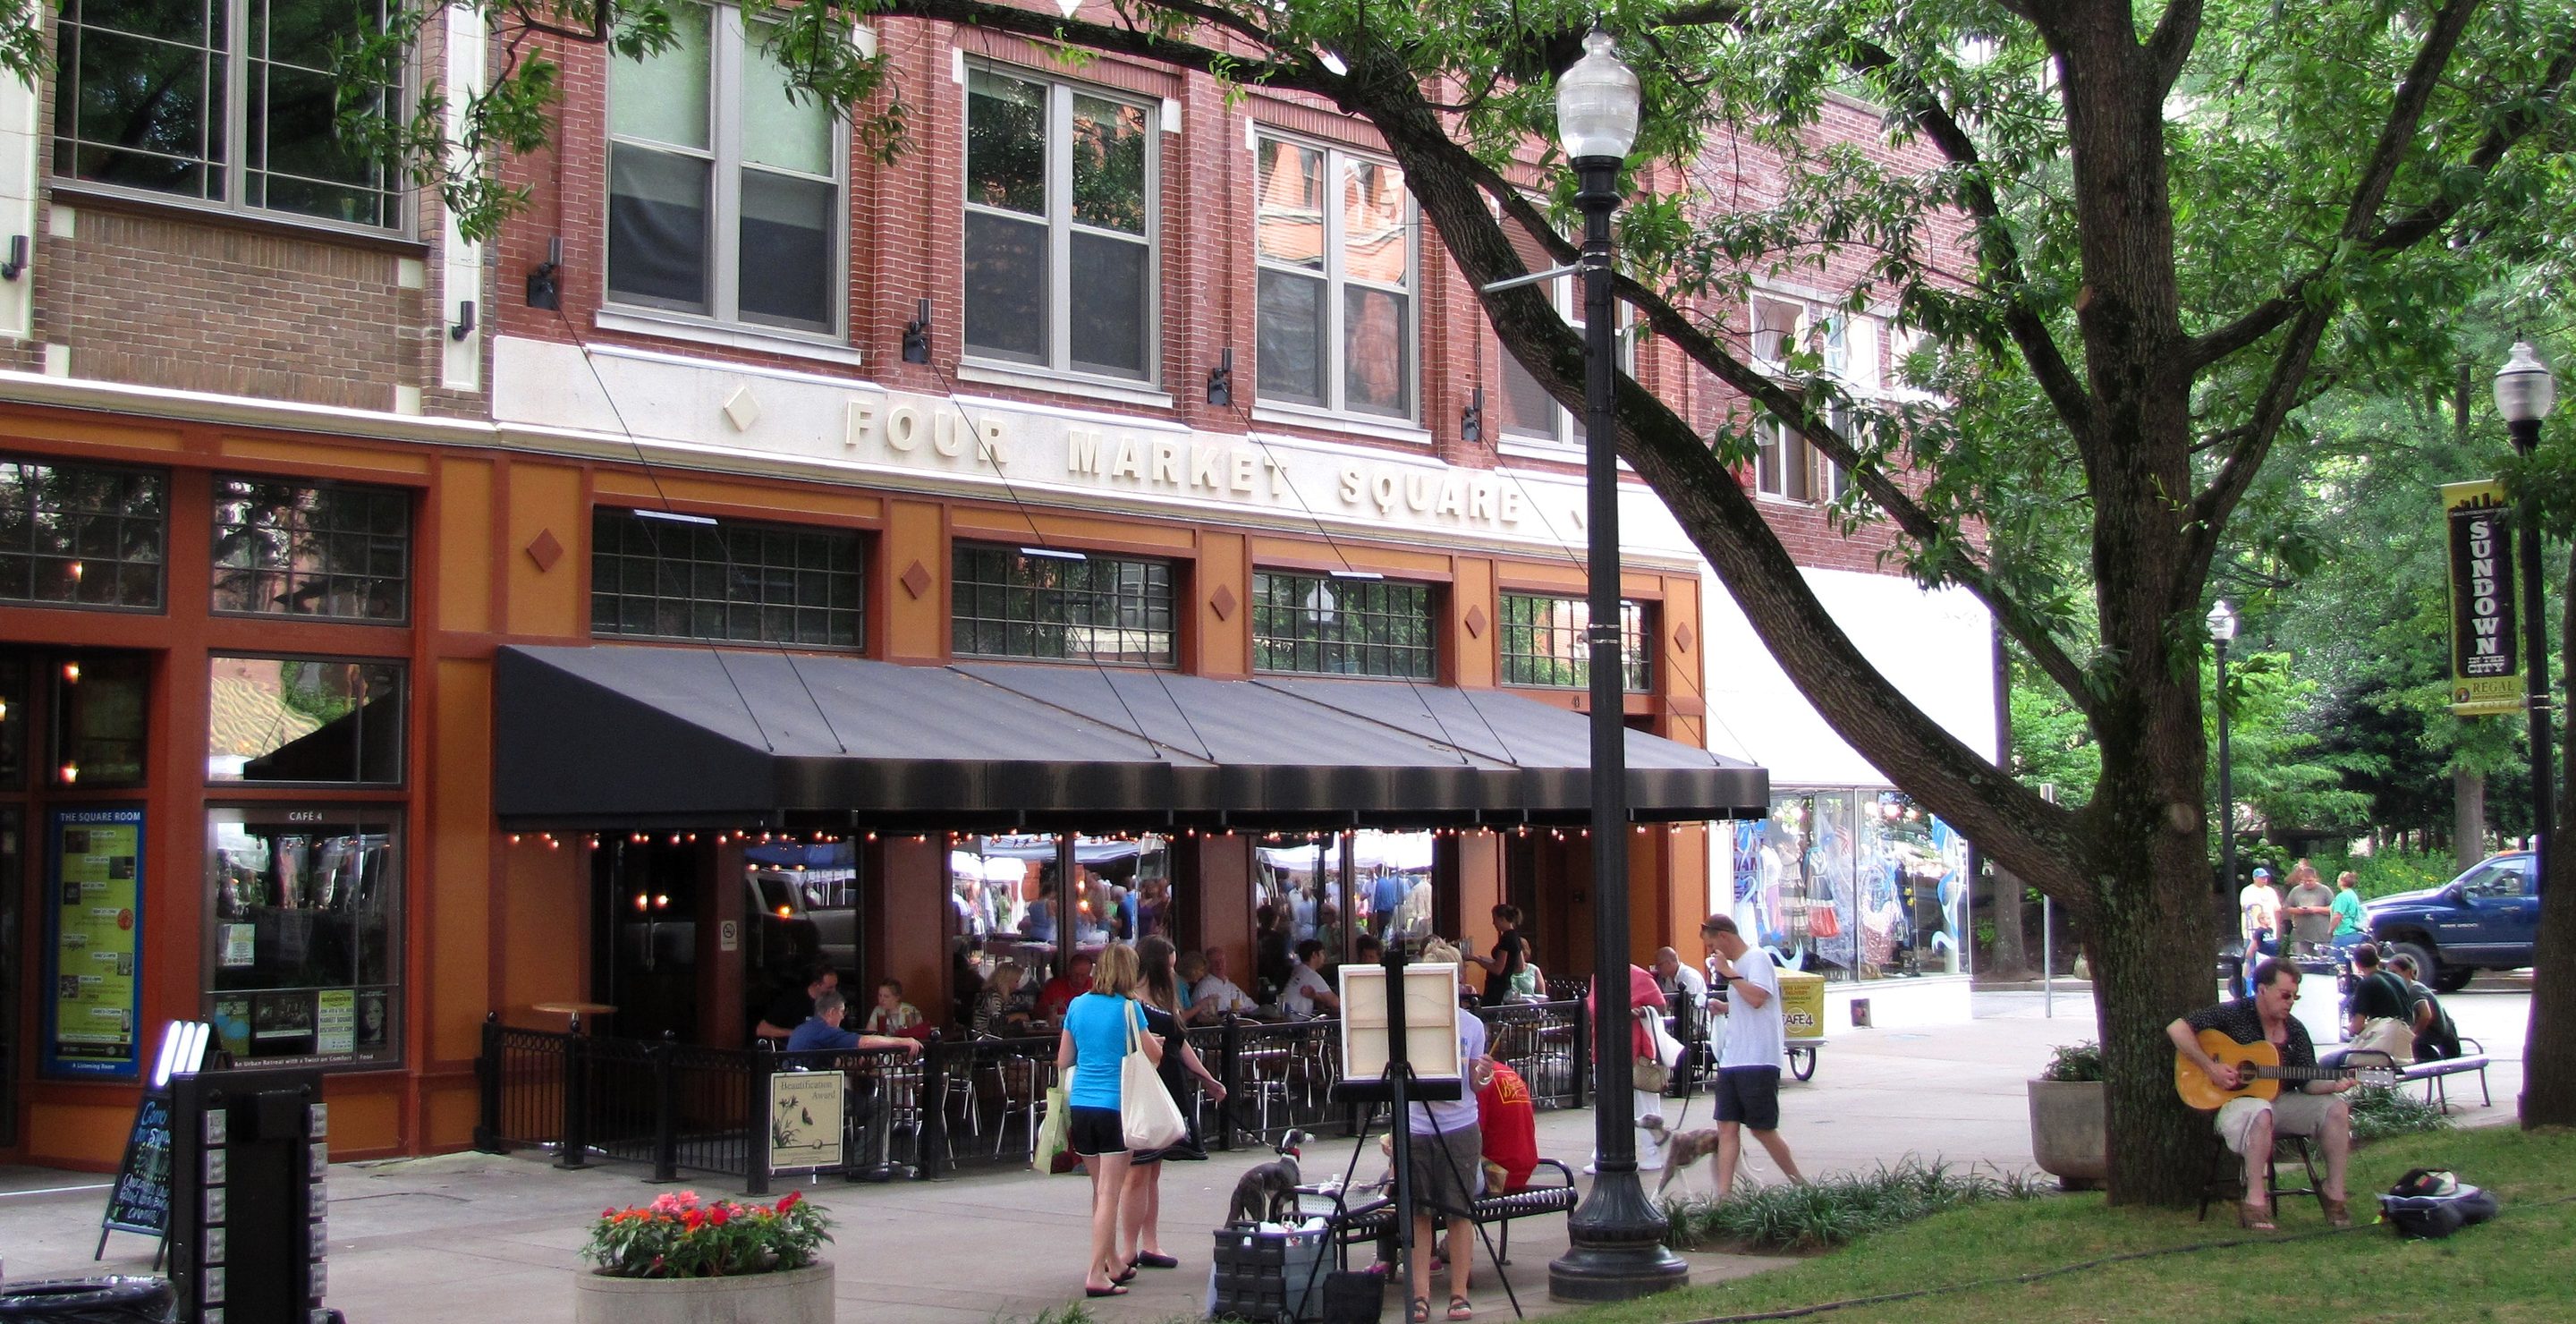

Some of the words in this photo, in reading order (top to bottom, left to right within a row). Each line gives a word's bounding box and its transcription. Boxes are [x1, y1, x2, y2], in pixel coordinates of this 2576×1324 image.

[845, 399, 1009, 463] FOUR
[1068, 429, 1288, 495] MARKET
[1338, 465, 1519, 522] SQUARE
[2469, 521, 2500, 655] SUNDOWN
[2467, 662, 2504, 674] CITY
[2472, 681, 2515, 693] REGAL
[60, 812, 77, 821] THE
[79, 812, 112, 822] SQUARE
[114, 811, 141, 820] ROOM
[317, 812, 323, 821] 4
[77, 1062, 100, 1070] Listening
[781, 1081, 833, 1091] Beautification
[812, 1090, 835, 1100] Award
